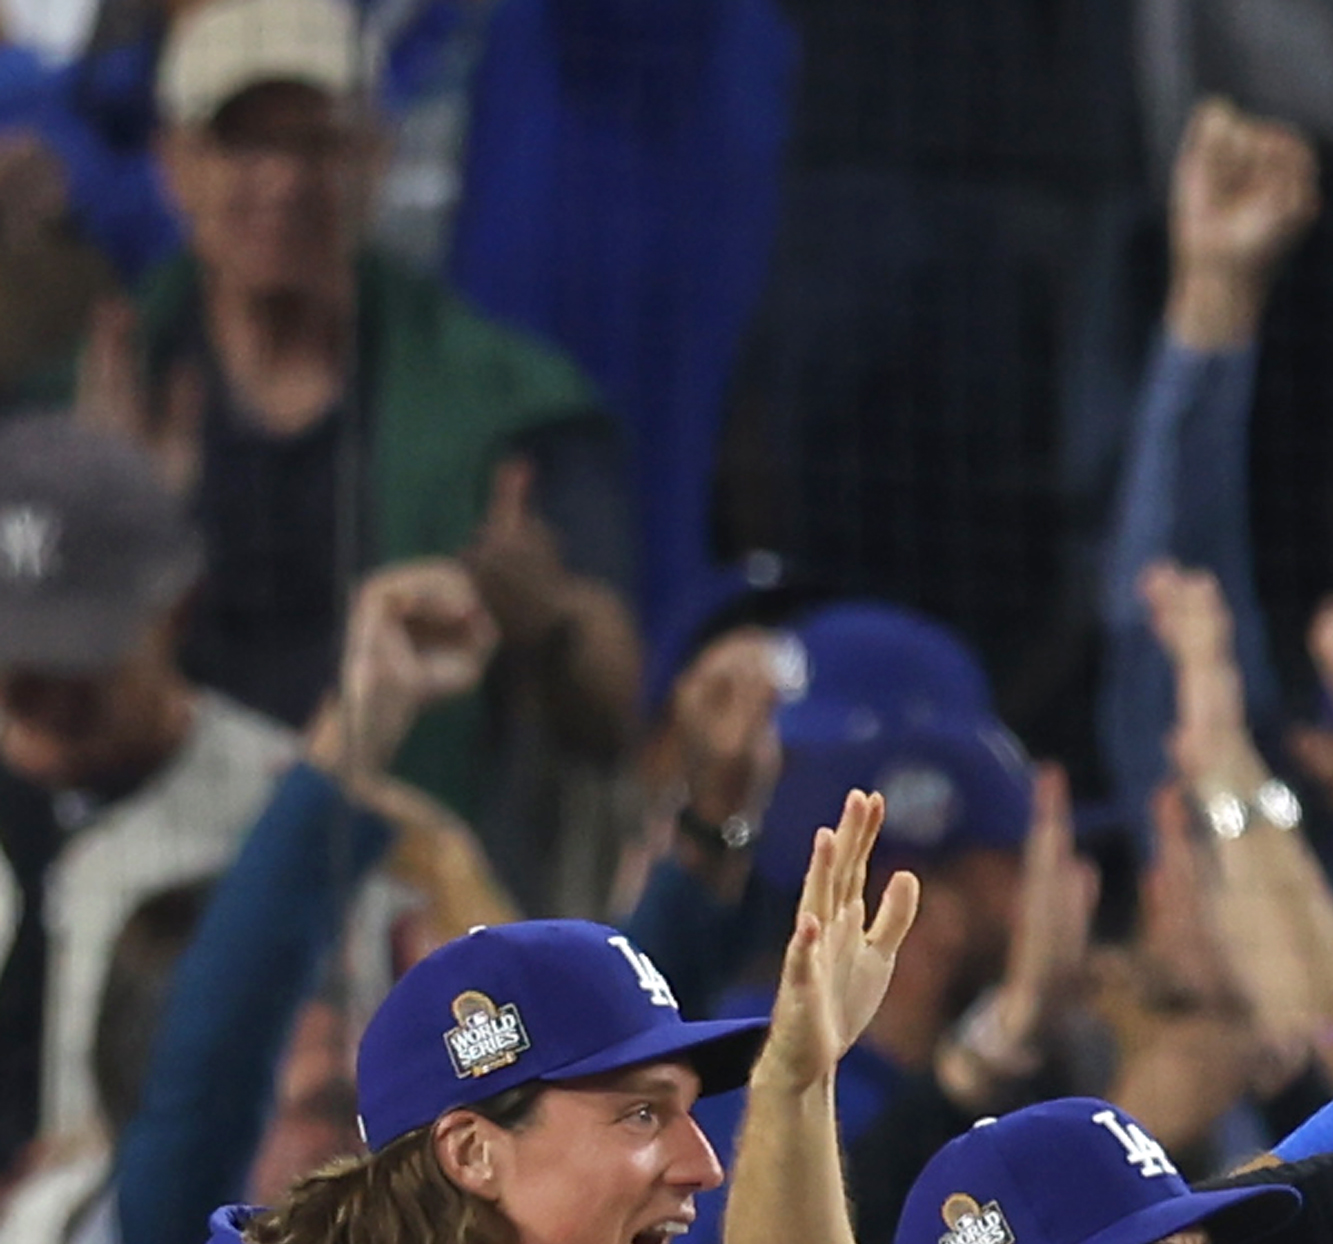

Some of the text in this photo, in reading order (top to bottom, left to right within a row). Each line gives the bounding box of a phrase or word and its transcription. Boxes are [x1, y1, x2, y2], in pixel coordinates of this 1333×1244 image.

[609, 936, 679, 1011] LA
[450, 1013, 517, 1052] WORLD
[458, 1031, 520, 1069] SERIES
[1092, 1109, 1178, 1178] LA
